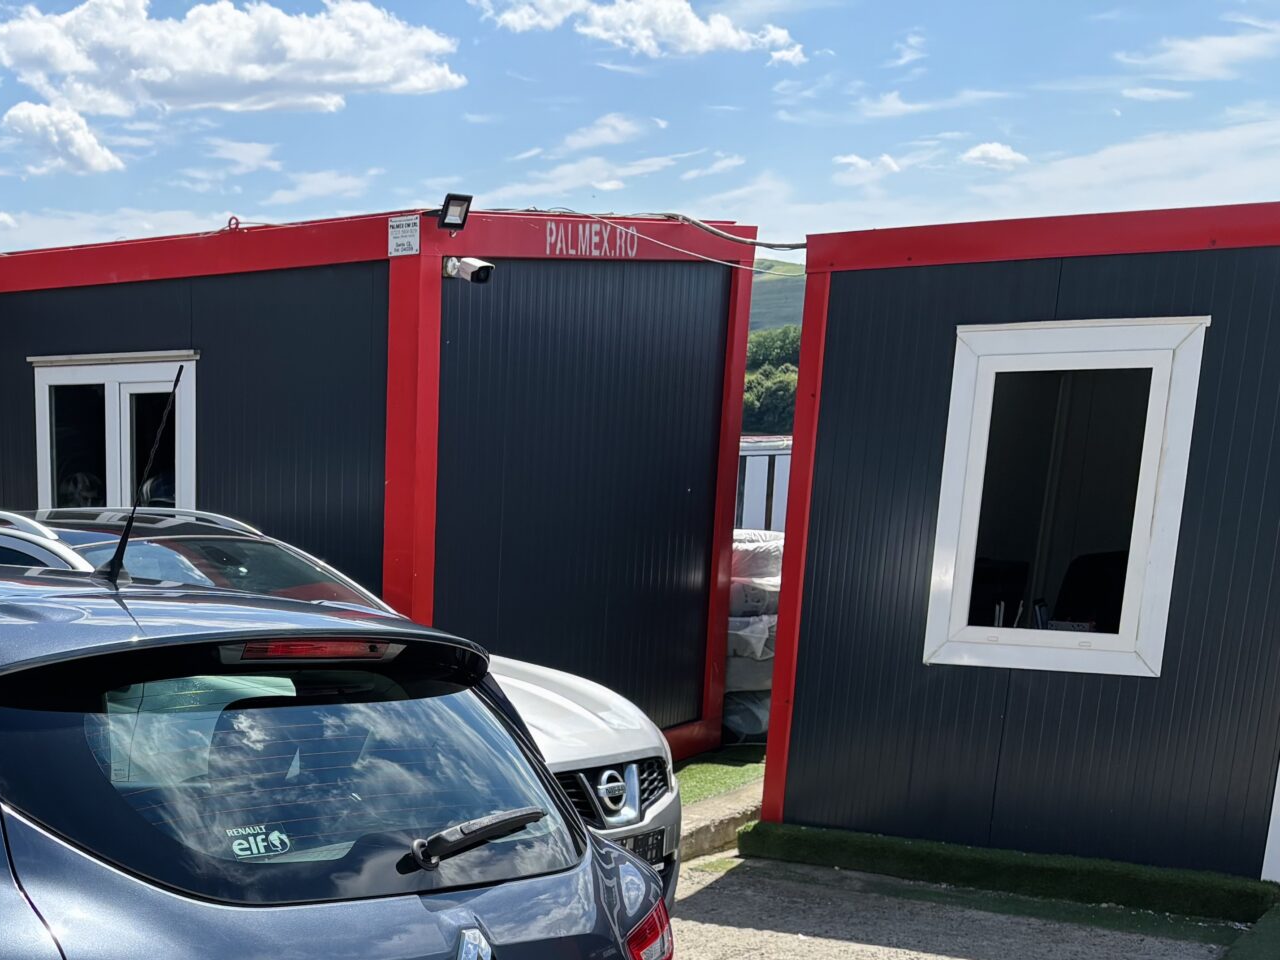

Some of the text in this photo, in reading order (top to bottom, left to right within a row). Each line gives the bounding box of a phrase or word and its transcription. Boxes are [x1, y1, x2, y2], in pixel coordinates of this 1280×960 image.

[545, 221, 638, 257] PALMEX.RO
[226, 825, 266, 837] RENAULT
[232, 834, 267, 856] elf
